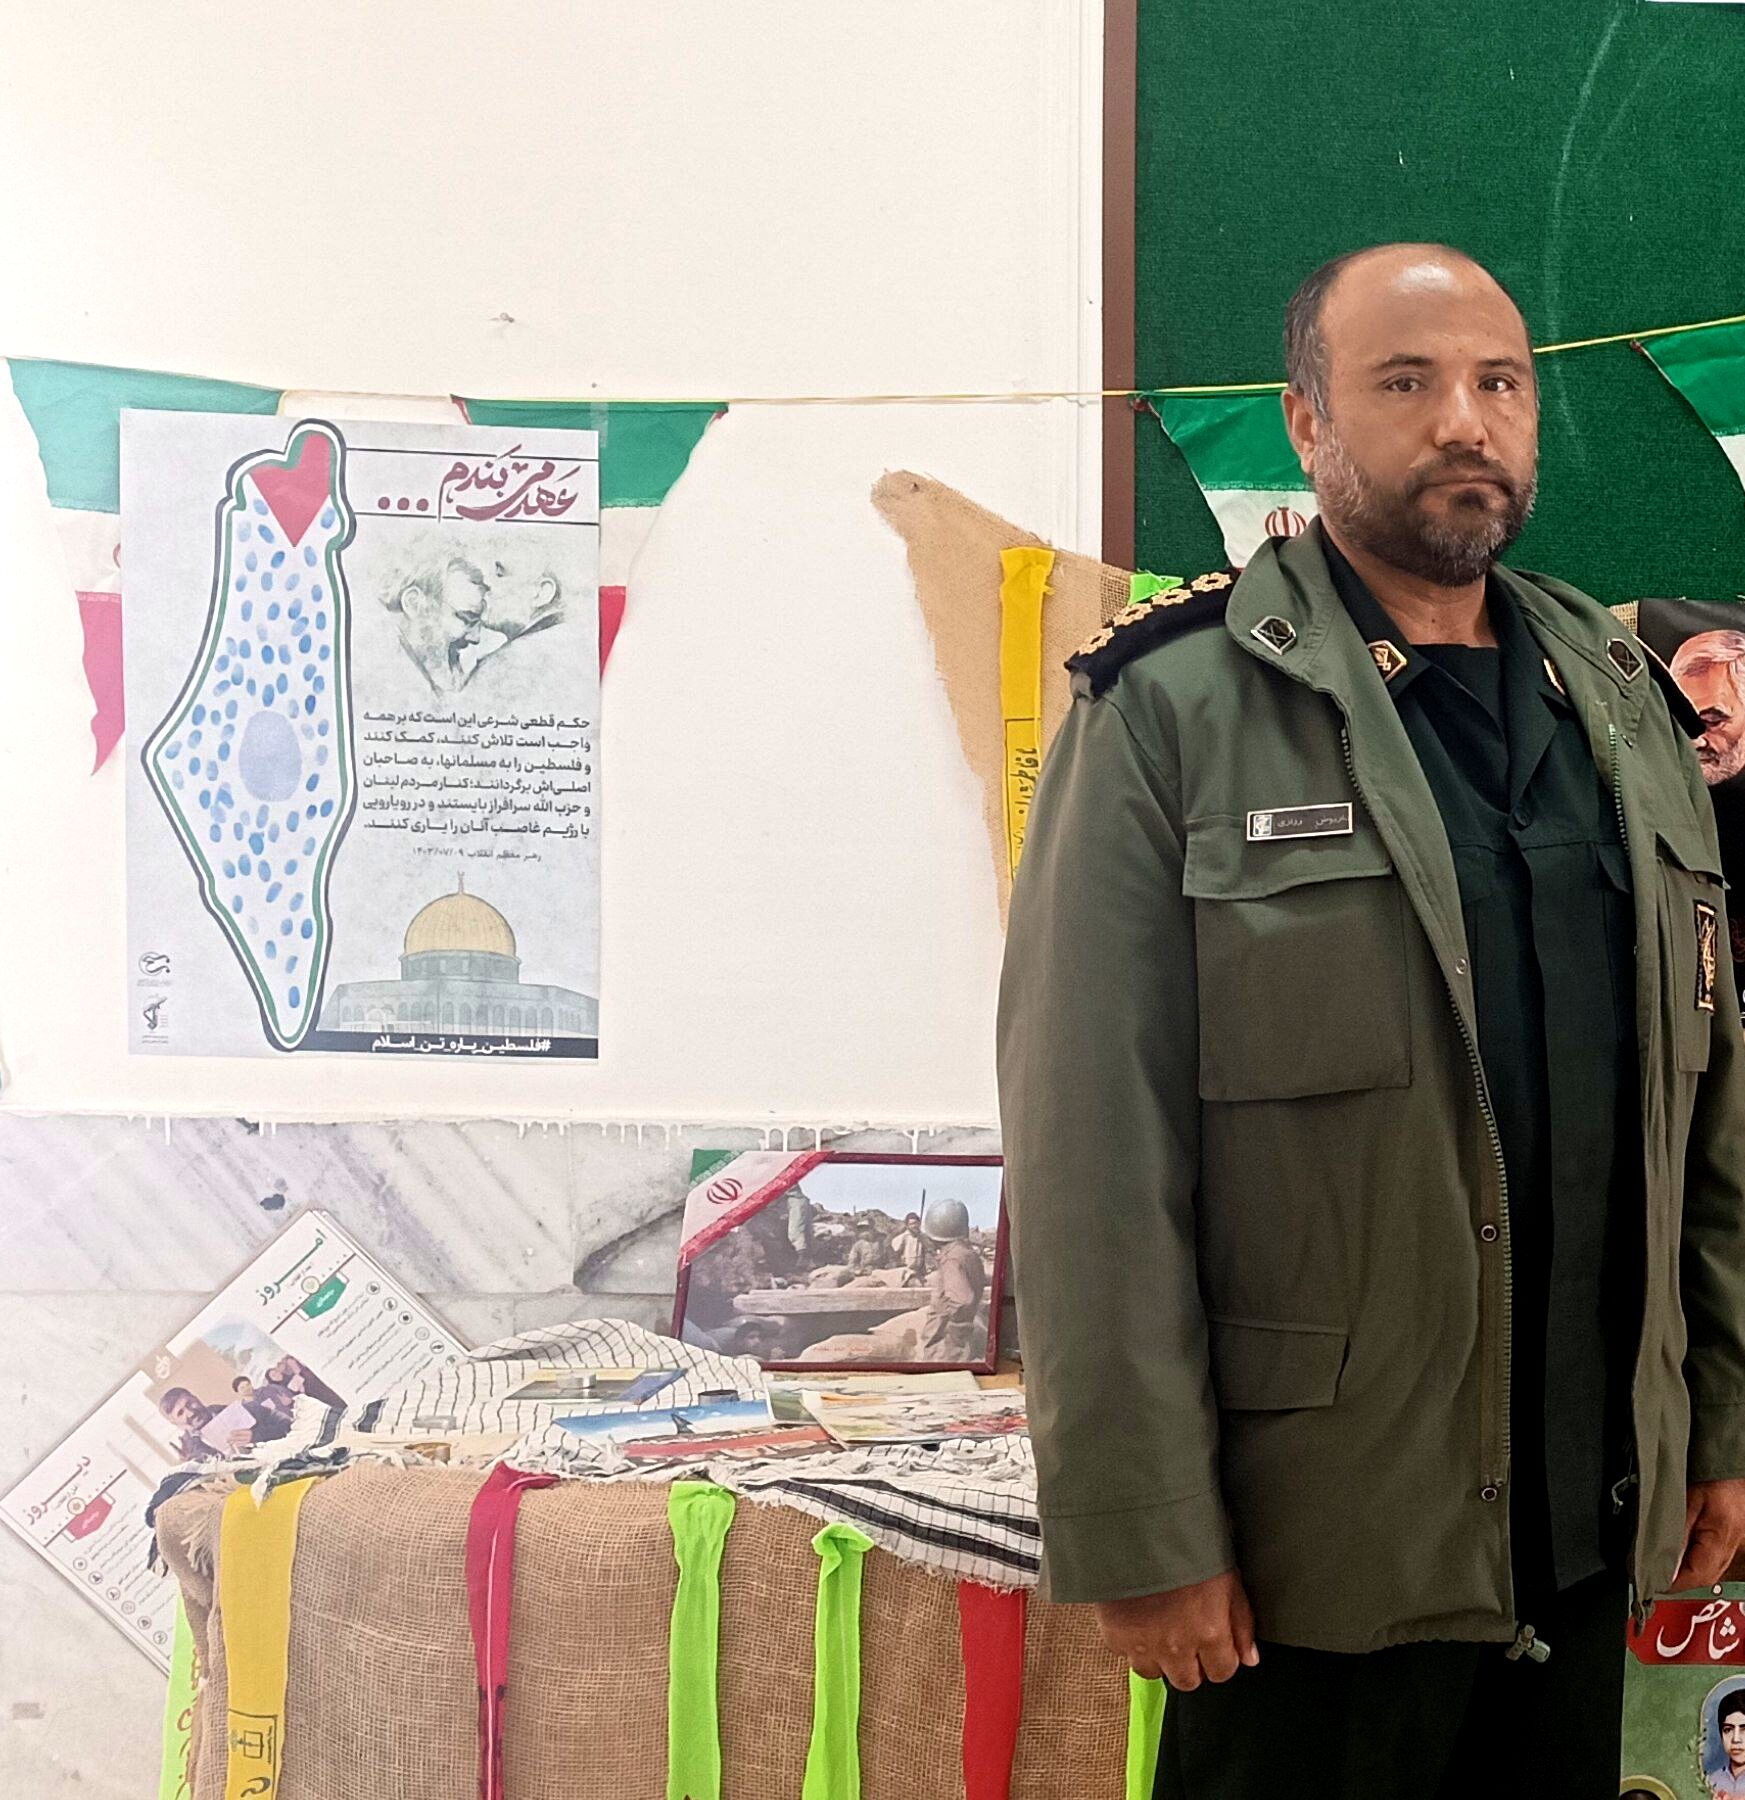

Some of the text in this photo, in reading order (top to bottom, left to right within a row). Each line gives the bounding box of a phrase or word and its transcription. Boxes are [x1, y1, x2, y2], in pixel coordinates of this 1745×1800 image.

[363, 711, 590, 731] حکم قطعی شرعی این است که بر همه
[363, 731, 393, 742] کنند
[394, 732, 435, 743] کمک
[481, 734, 514, 749] تلاش
[516, 735, 545, 748] است
[549, 736, 591, 752] واجب
[363, 751, 418, 766] صاحبان
[420, 755, 434, 767] به
[499, 758, 512, 770] به
[513, 757, 521, 773] را
[524, 757, 582, 774] فلسطین
[584, 762, 591, 775] و
[363, 774, 400, 788] لبنان
[400, 777, 437, 791] مردم
[438, 777, 470, 791] کنار
[362, 794, 591, 817] و حزب الله سرافراز بایستند و در رویارویی
[411, 818, 449, 833] یاری
[450, 819, 458, 834] را
[460, 817, 489, 834] آنان
[490, 822, 541, 837] غاصب
[543, 823, 579, 839] رژیم
[580, 824, 590, 840] با
[26, 1455, 91, 1526] دیروز
[1656, 1584, 1741, 1661] شاخص
